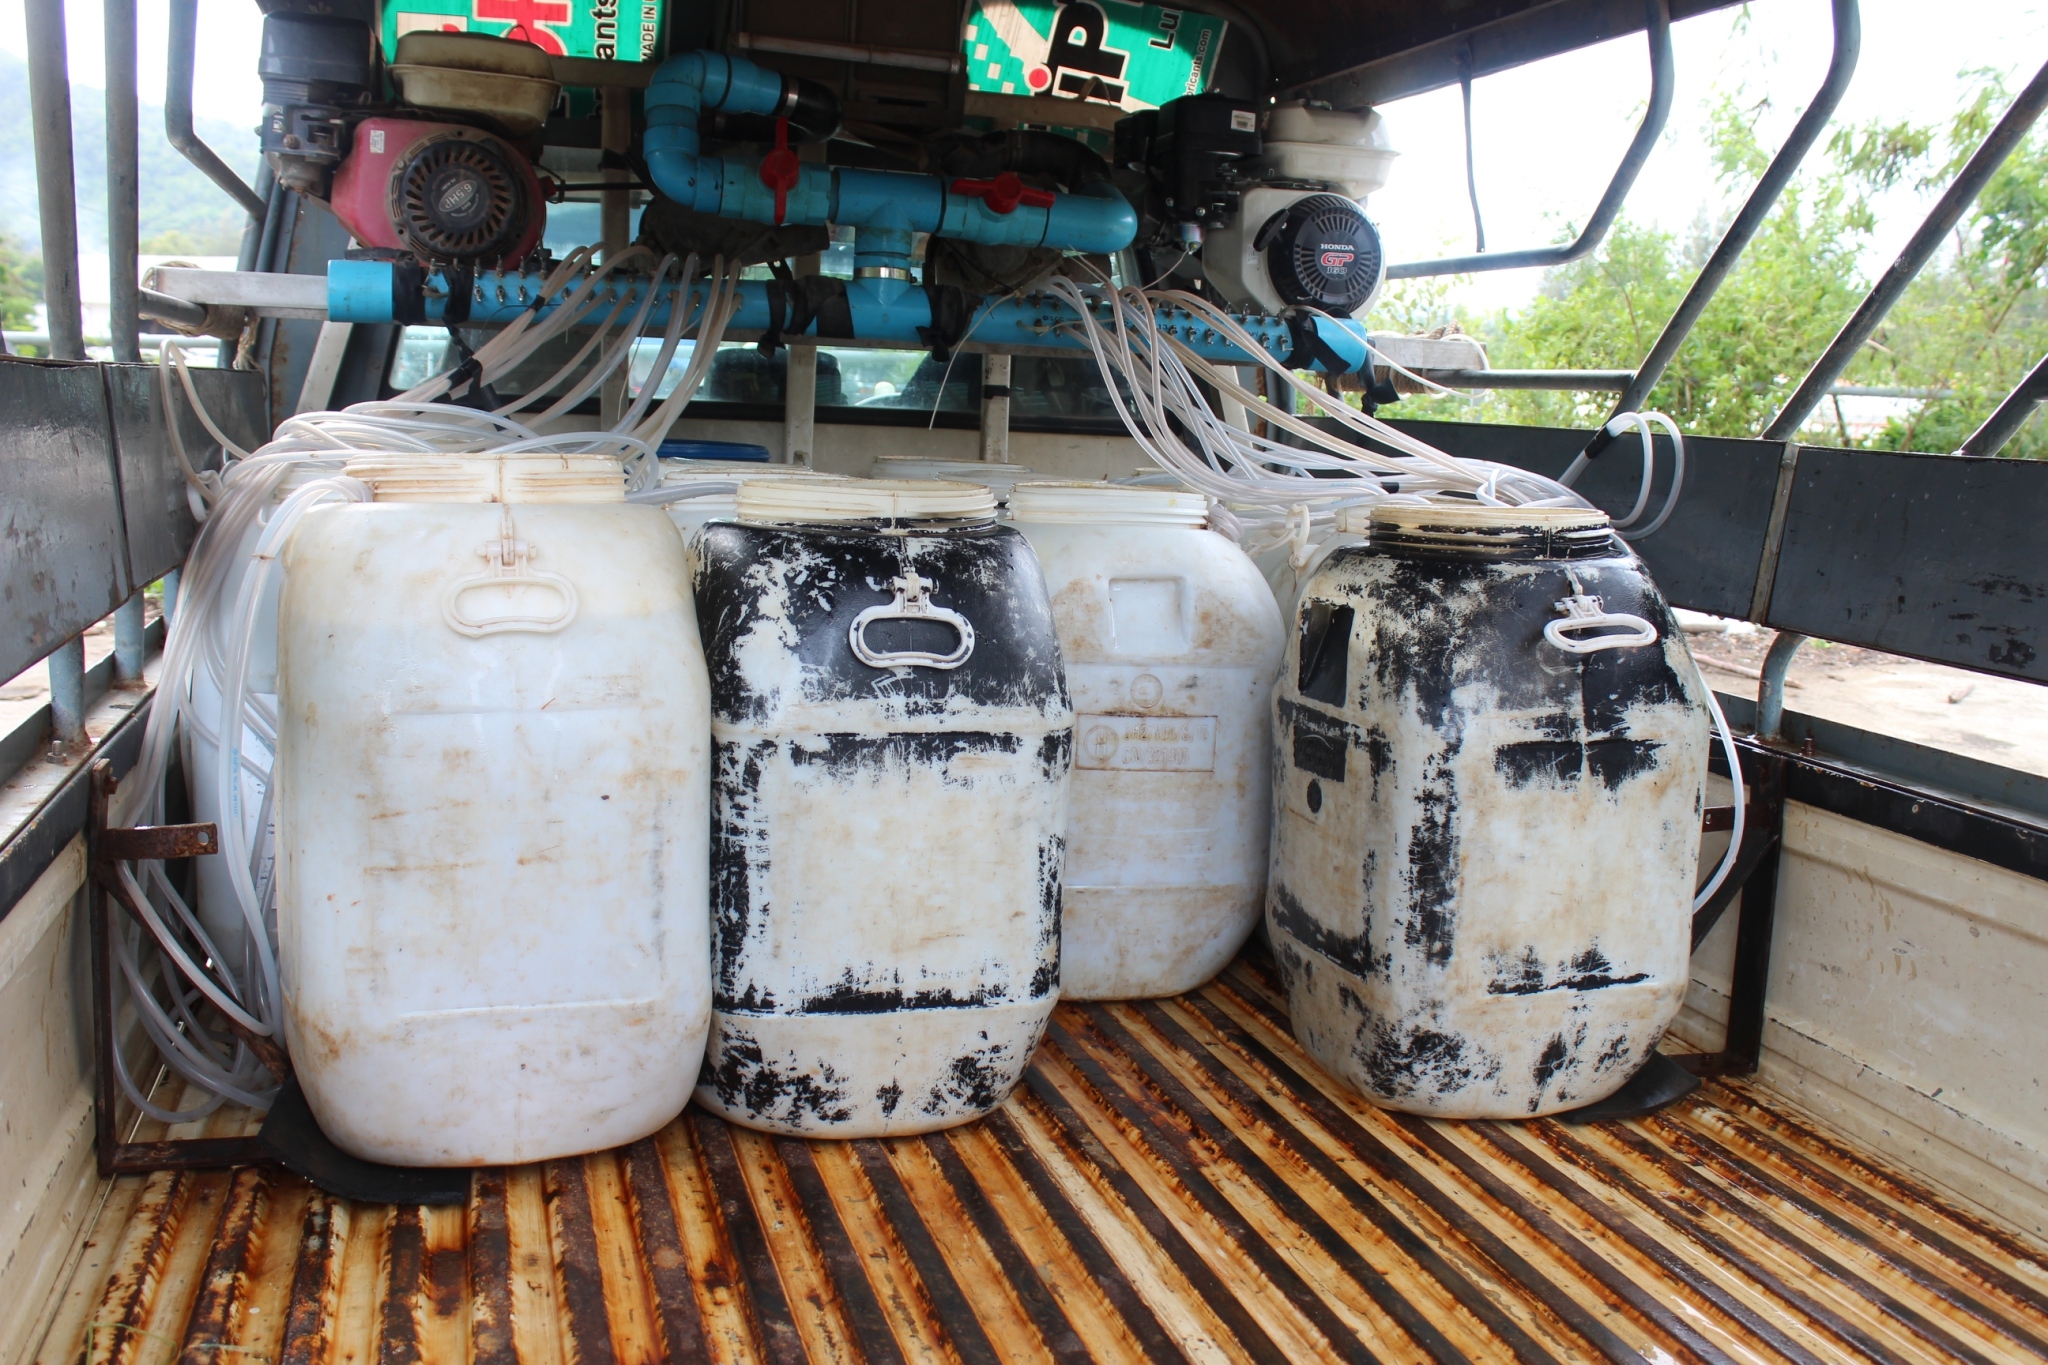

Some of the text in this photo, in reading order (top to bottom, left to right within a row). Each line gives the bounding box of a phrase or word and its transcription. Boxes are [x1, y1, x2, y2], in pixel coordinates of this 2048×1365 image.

[642, 5, 656, 20] IN
[1149, 5, 1183, 50] Lu
[444, 182, 473, 209] 6.5HP
[1320, 243, 1355, 251] HONDA
[1320, 251, 1354, 267] GP
